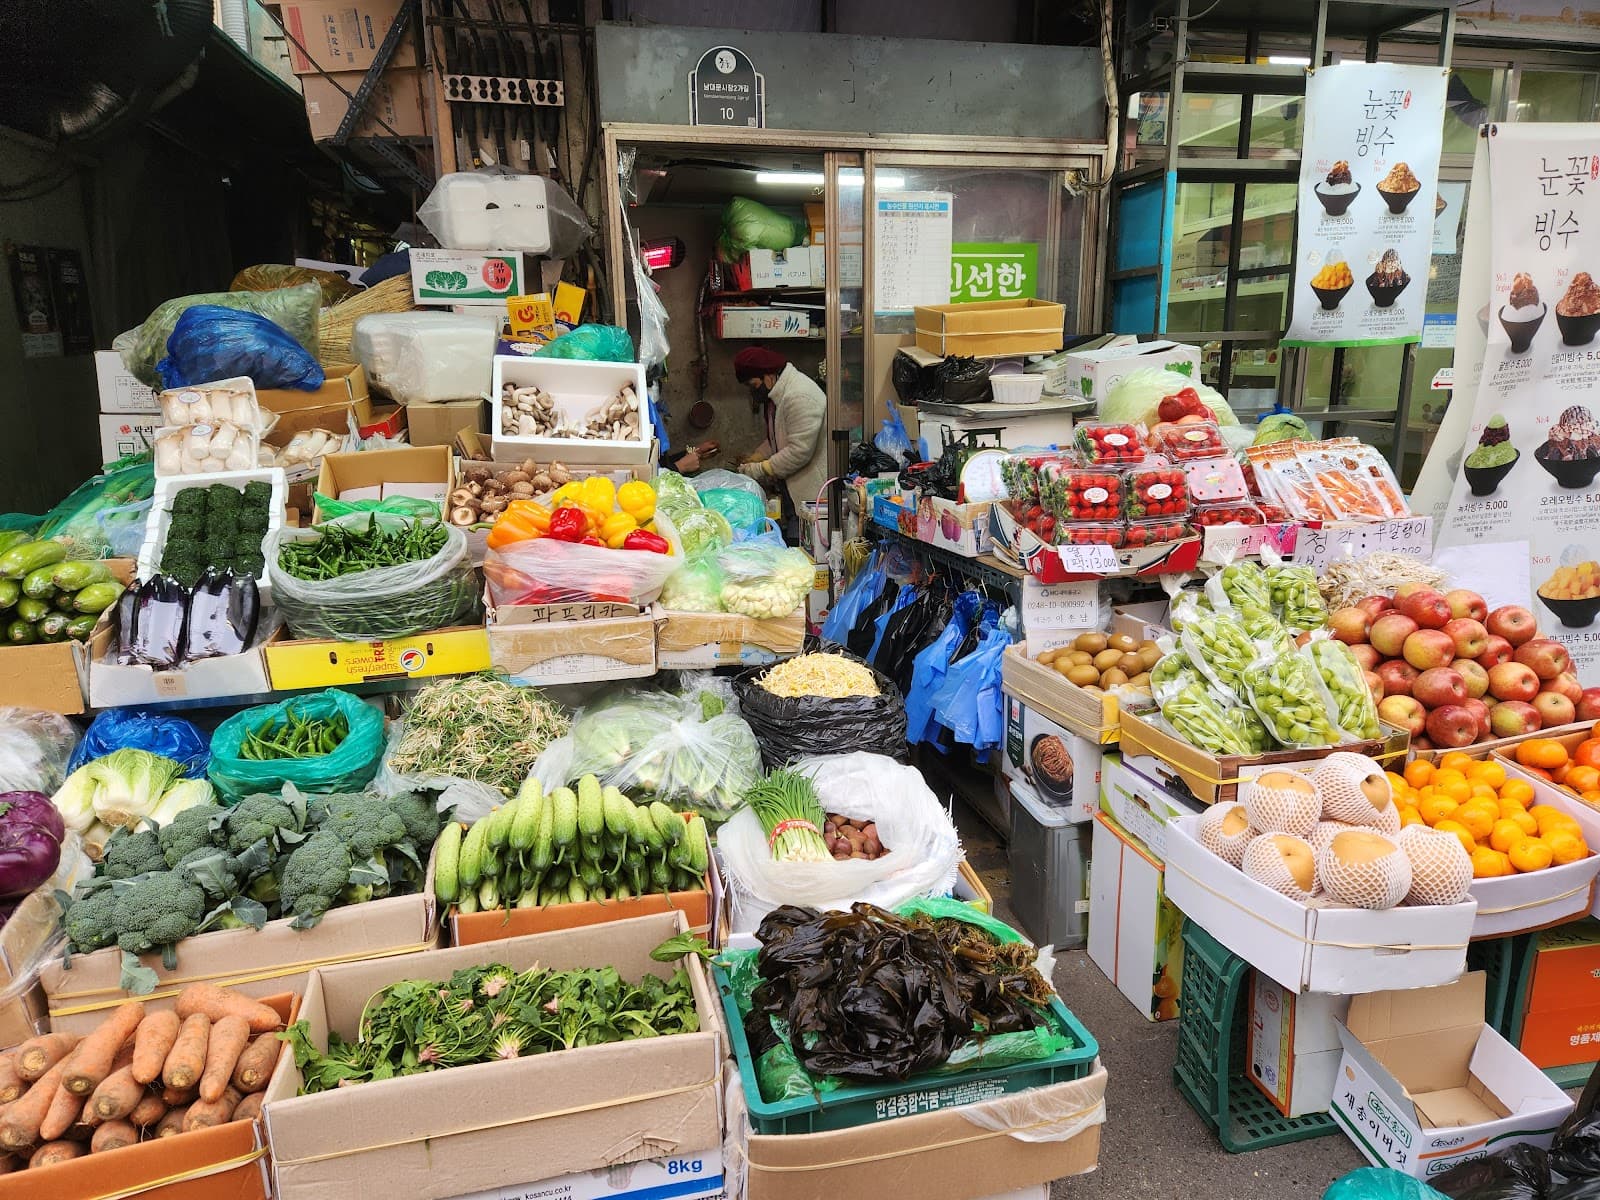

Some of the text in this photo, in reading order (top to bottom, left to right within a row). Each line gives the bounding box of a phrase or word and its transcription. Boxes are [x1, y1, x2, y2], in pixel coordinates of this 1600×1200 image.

[1363, 89, 1404, 120] 눈꽃
[720, 107, 734, 120] 10
[1356, 125, 1395, 157] 빙수
[1537, 156, 1590, 196] 눈꽃
[1535, 209, 1580, 251] 빙수
[1485, 500, 1508, 511] 5,000
[1540, 494, 1583, 507] 오레오빙수
[1532, 556, 1551, 565] No.6
[532, 605, 623, 622] 파프리카
[875, 1092, 940, 1119] 한결종합식품
[668, 1159, 702, 1175] 8kg
